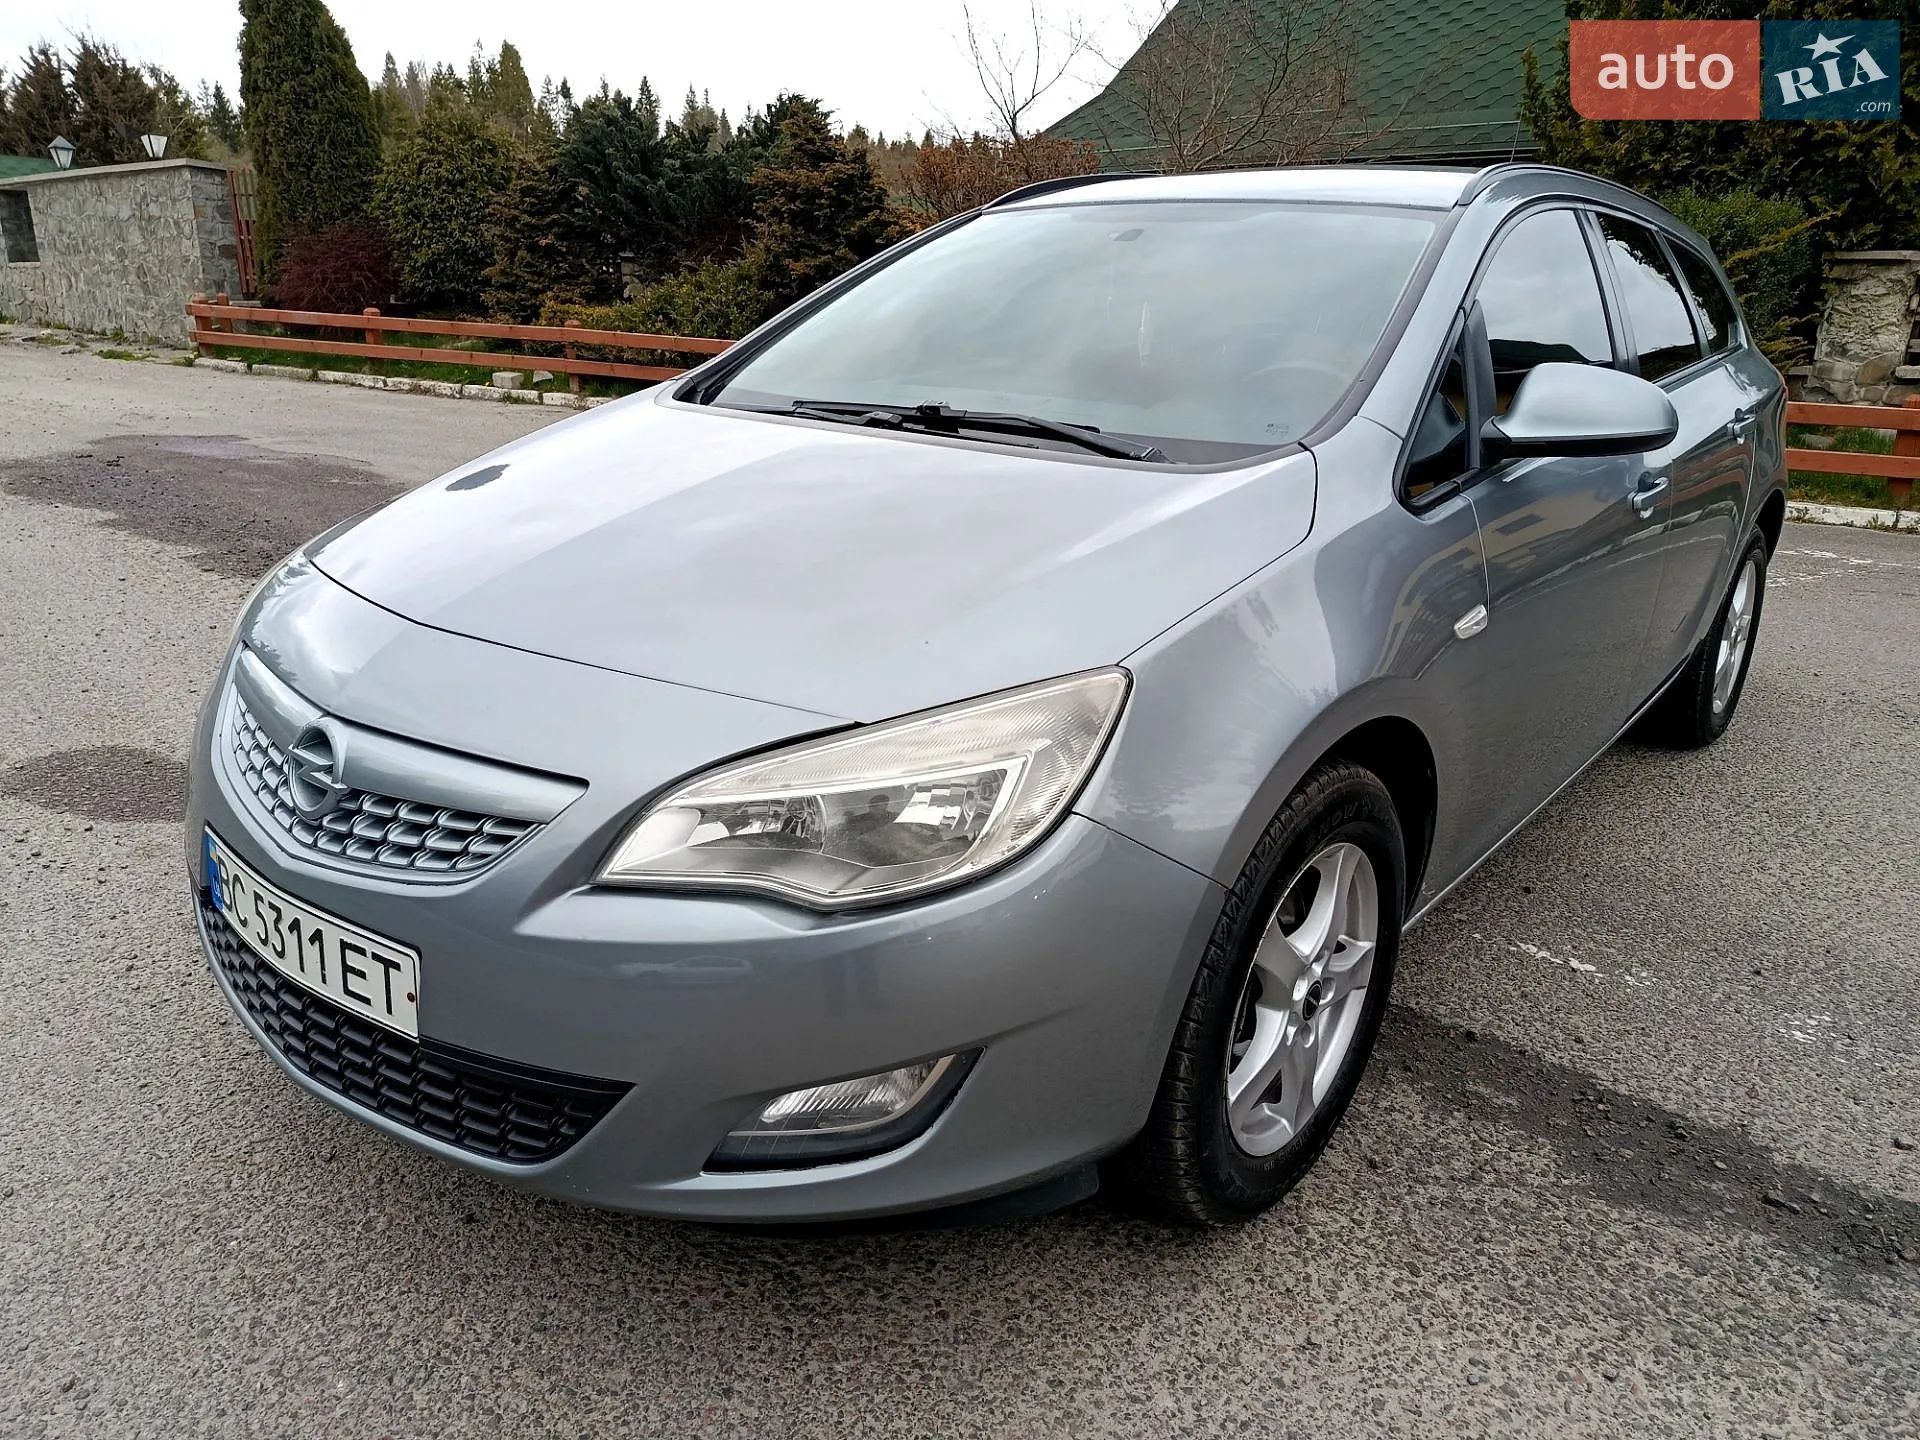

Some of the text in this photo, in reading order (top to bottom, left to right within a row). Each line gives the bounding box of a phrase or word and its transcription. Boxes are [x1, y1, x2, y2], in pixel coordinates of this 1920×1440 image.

[217, 854, 402, 1016] BC 5311 ET
